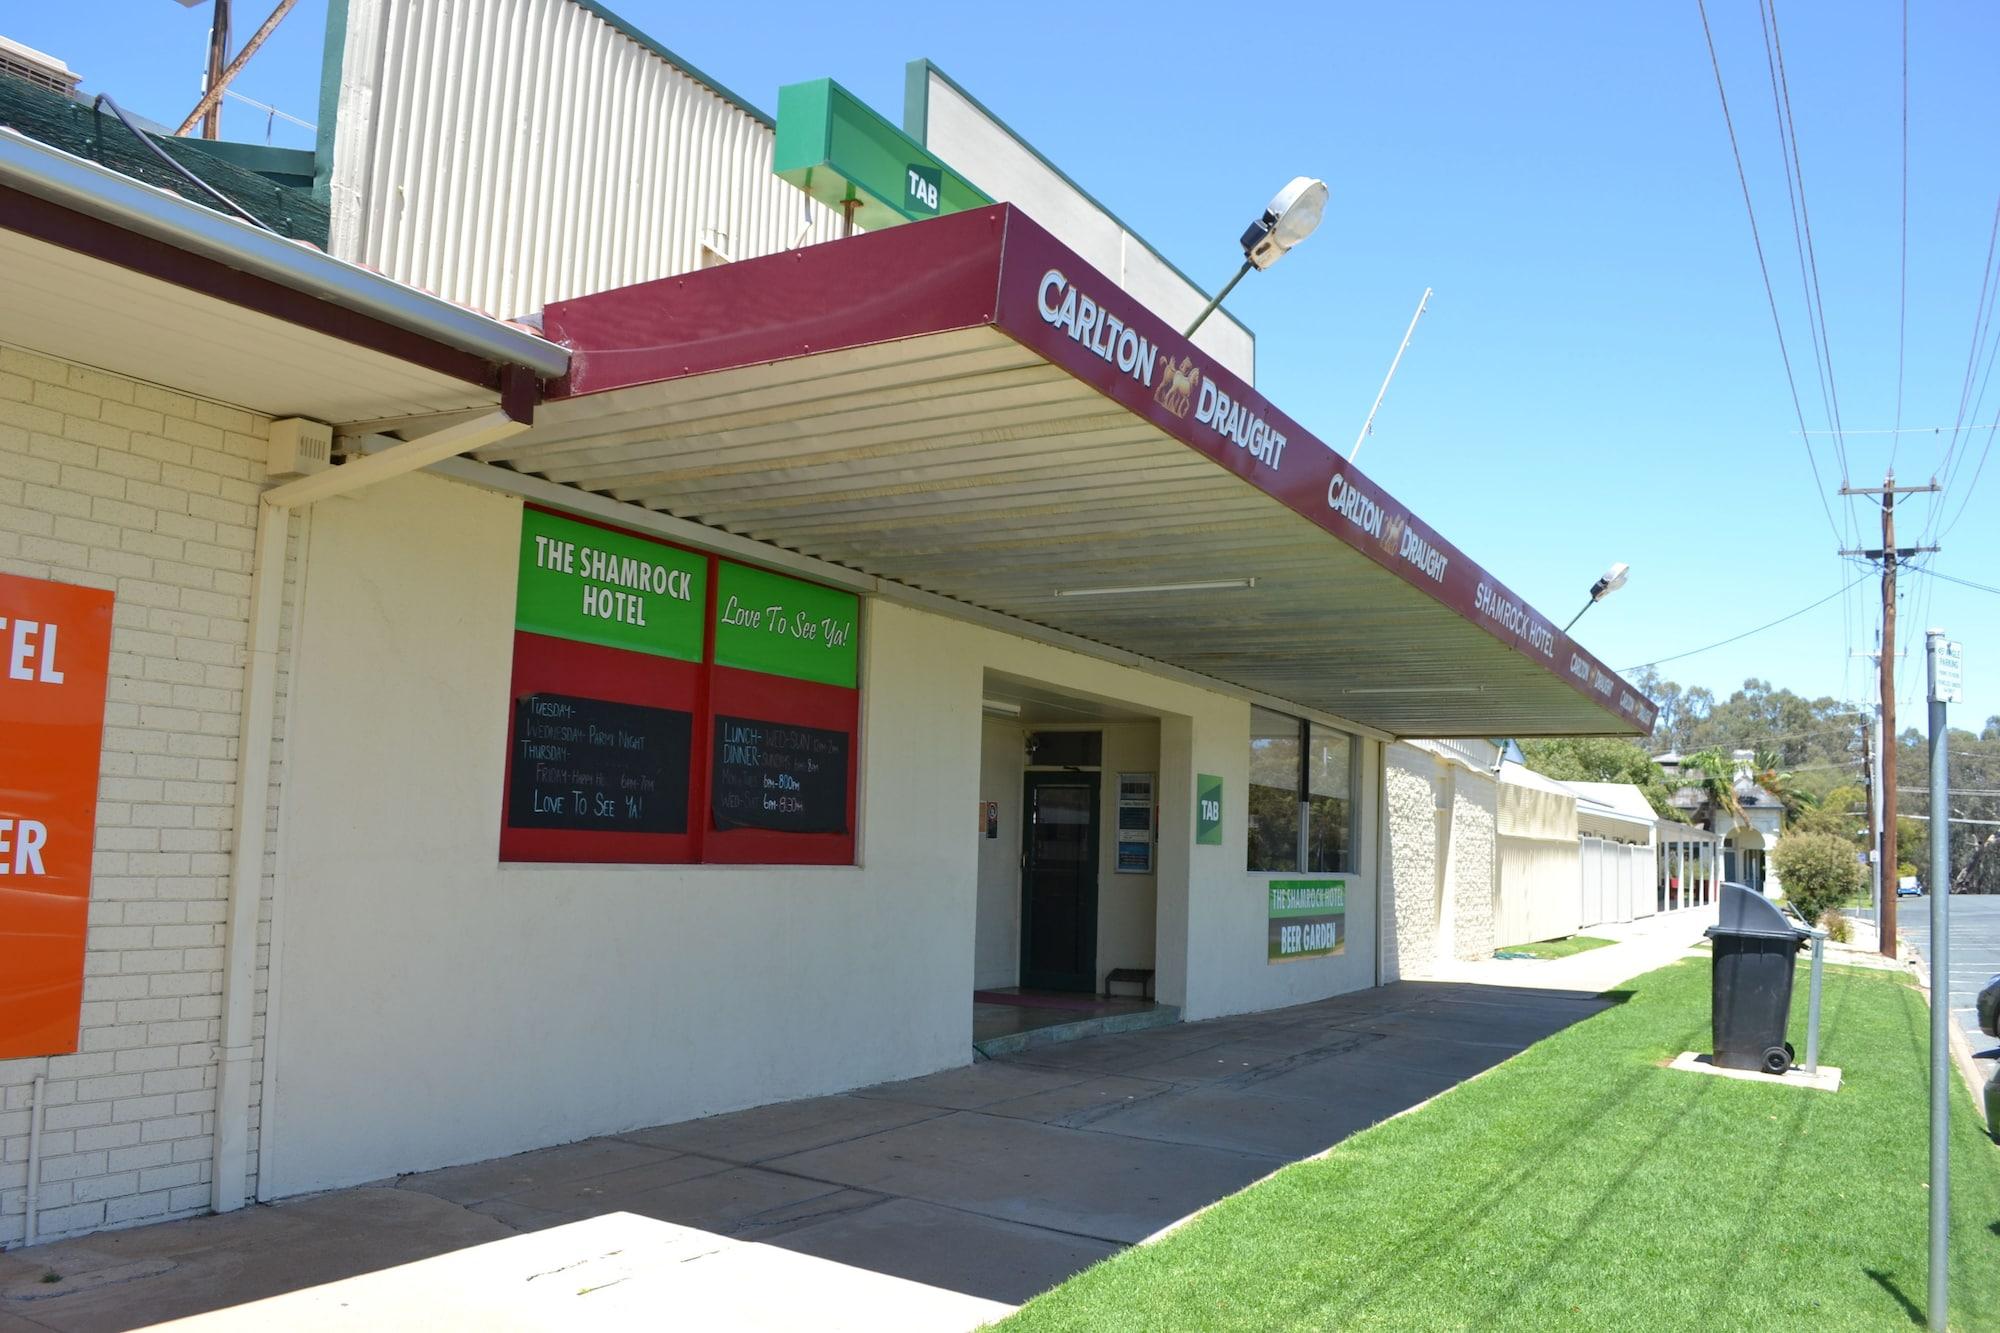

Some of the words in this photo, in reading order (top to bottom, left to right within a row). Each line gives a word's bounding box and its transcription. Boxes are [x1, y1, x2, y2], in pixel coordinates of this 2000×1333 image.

[908, 169, 938, 210] TAB
[1037, 268, 1159, 388] CARLTON
[1195, 375, 1287, 471] DRAUGHT
[1327, 472, 1385, 538] CARLTON
[1400, 524, 1449, 583] DRAUGHT
[535, 534, 575, 575] THE
[580, 546, 693, 602] SHAMROCK
[582, 584, 647, 628] HOTEL
[721, 595, 762, 630] Love
[765, 605, 787, 636] To
[790, 610, 818, 642] See
[821, 617, 851, 650] Ya!
[1474, 581, 1530, 641] SHAMROCK
[1527, 620, 1554, 658] HOTEL
[534, 789, 565, 814] LOVE
[572, 790, 588, 815] TO
[593, 792, 615, 817] SEE
[1201, 799, 1220, 821] TAB
[1273, 888, 1286, 910] THE
[1287, 887, 1324, 909] SHAMROCK
[1325, 886, 1344, 907] HOTEL
[1280, 925, 1302, 954] BEER
[1303, 922, 1336, 951] GARDEN
